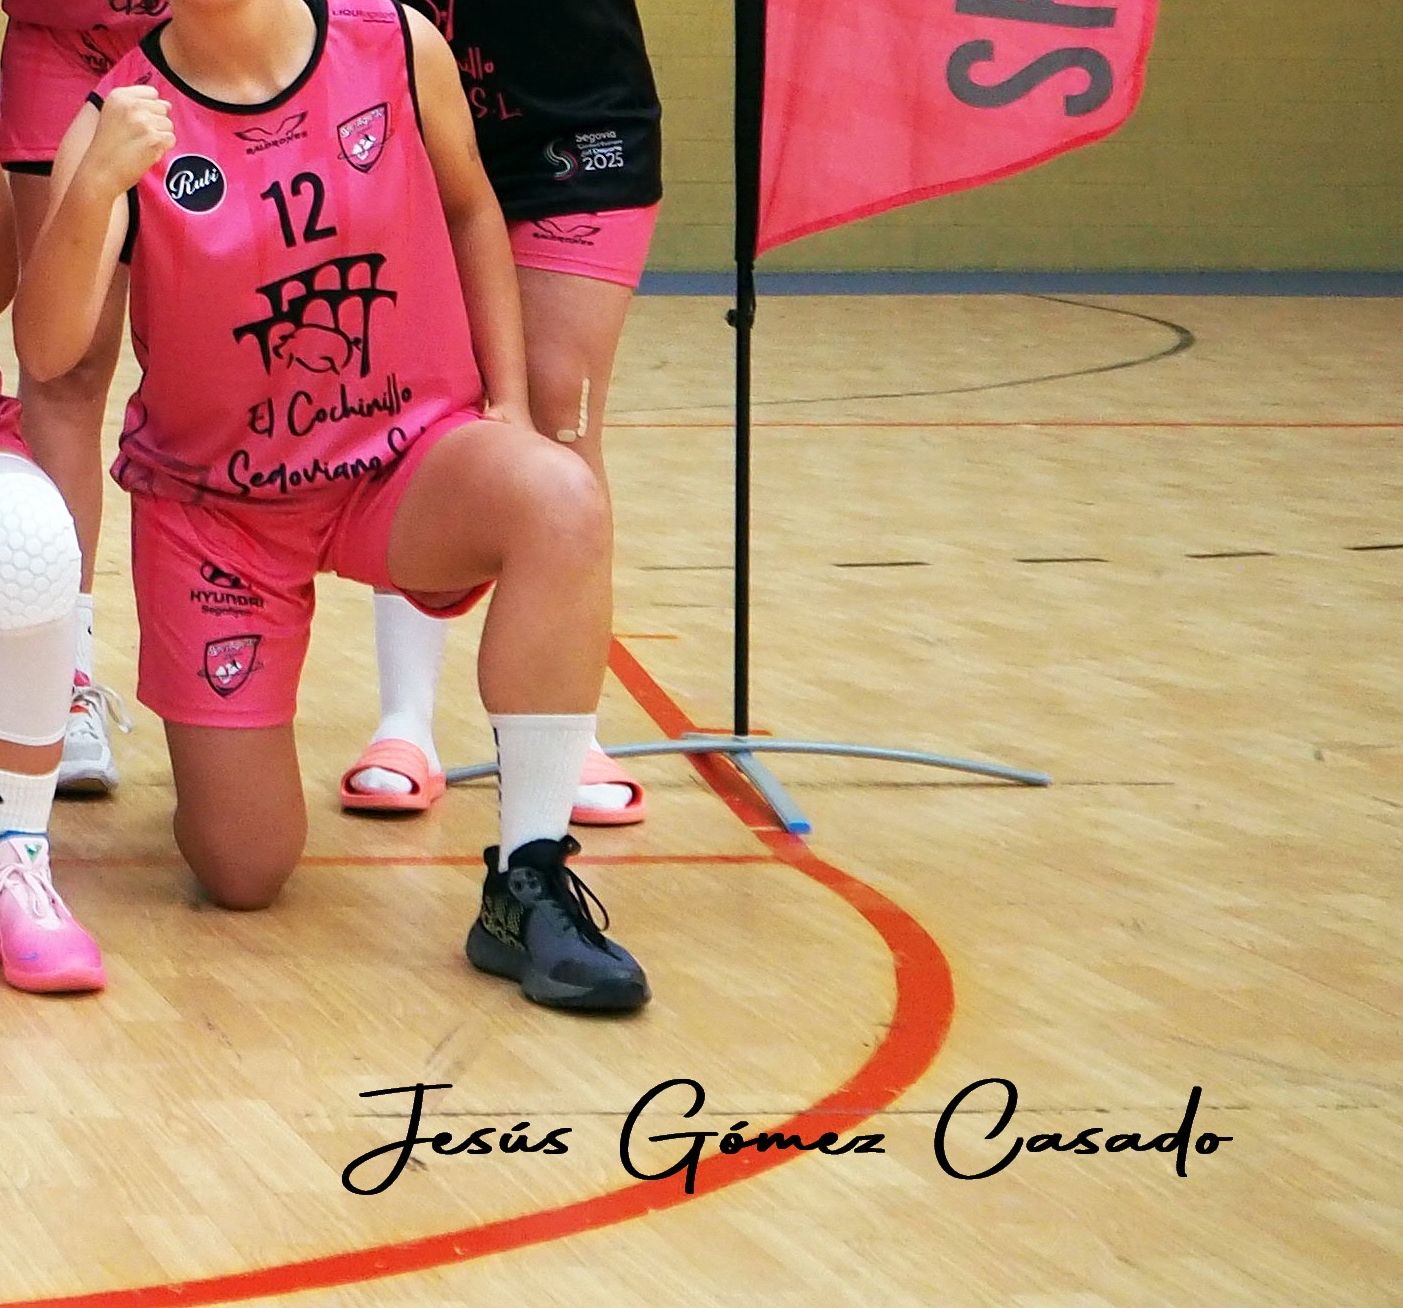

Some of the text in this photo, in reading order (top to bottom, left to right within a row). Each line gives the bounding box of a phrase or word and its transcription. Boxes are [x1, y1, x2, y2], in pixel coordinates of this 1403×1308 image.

[581, 151, 624, 171] 2025
[169, 167, 219, 200] Rubi
[260, 171, 338, 248] 12
[248, 372, 413, 438] El Cochinillo
[227, 449, 383, 497] Segoviano
[190, 590, 264, 608] HYUNDAI
